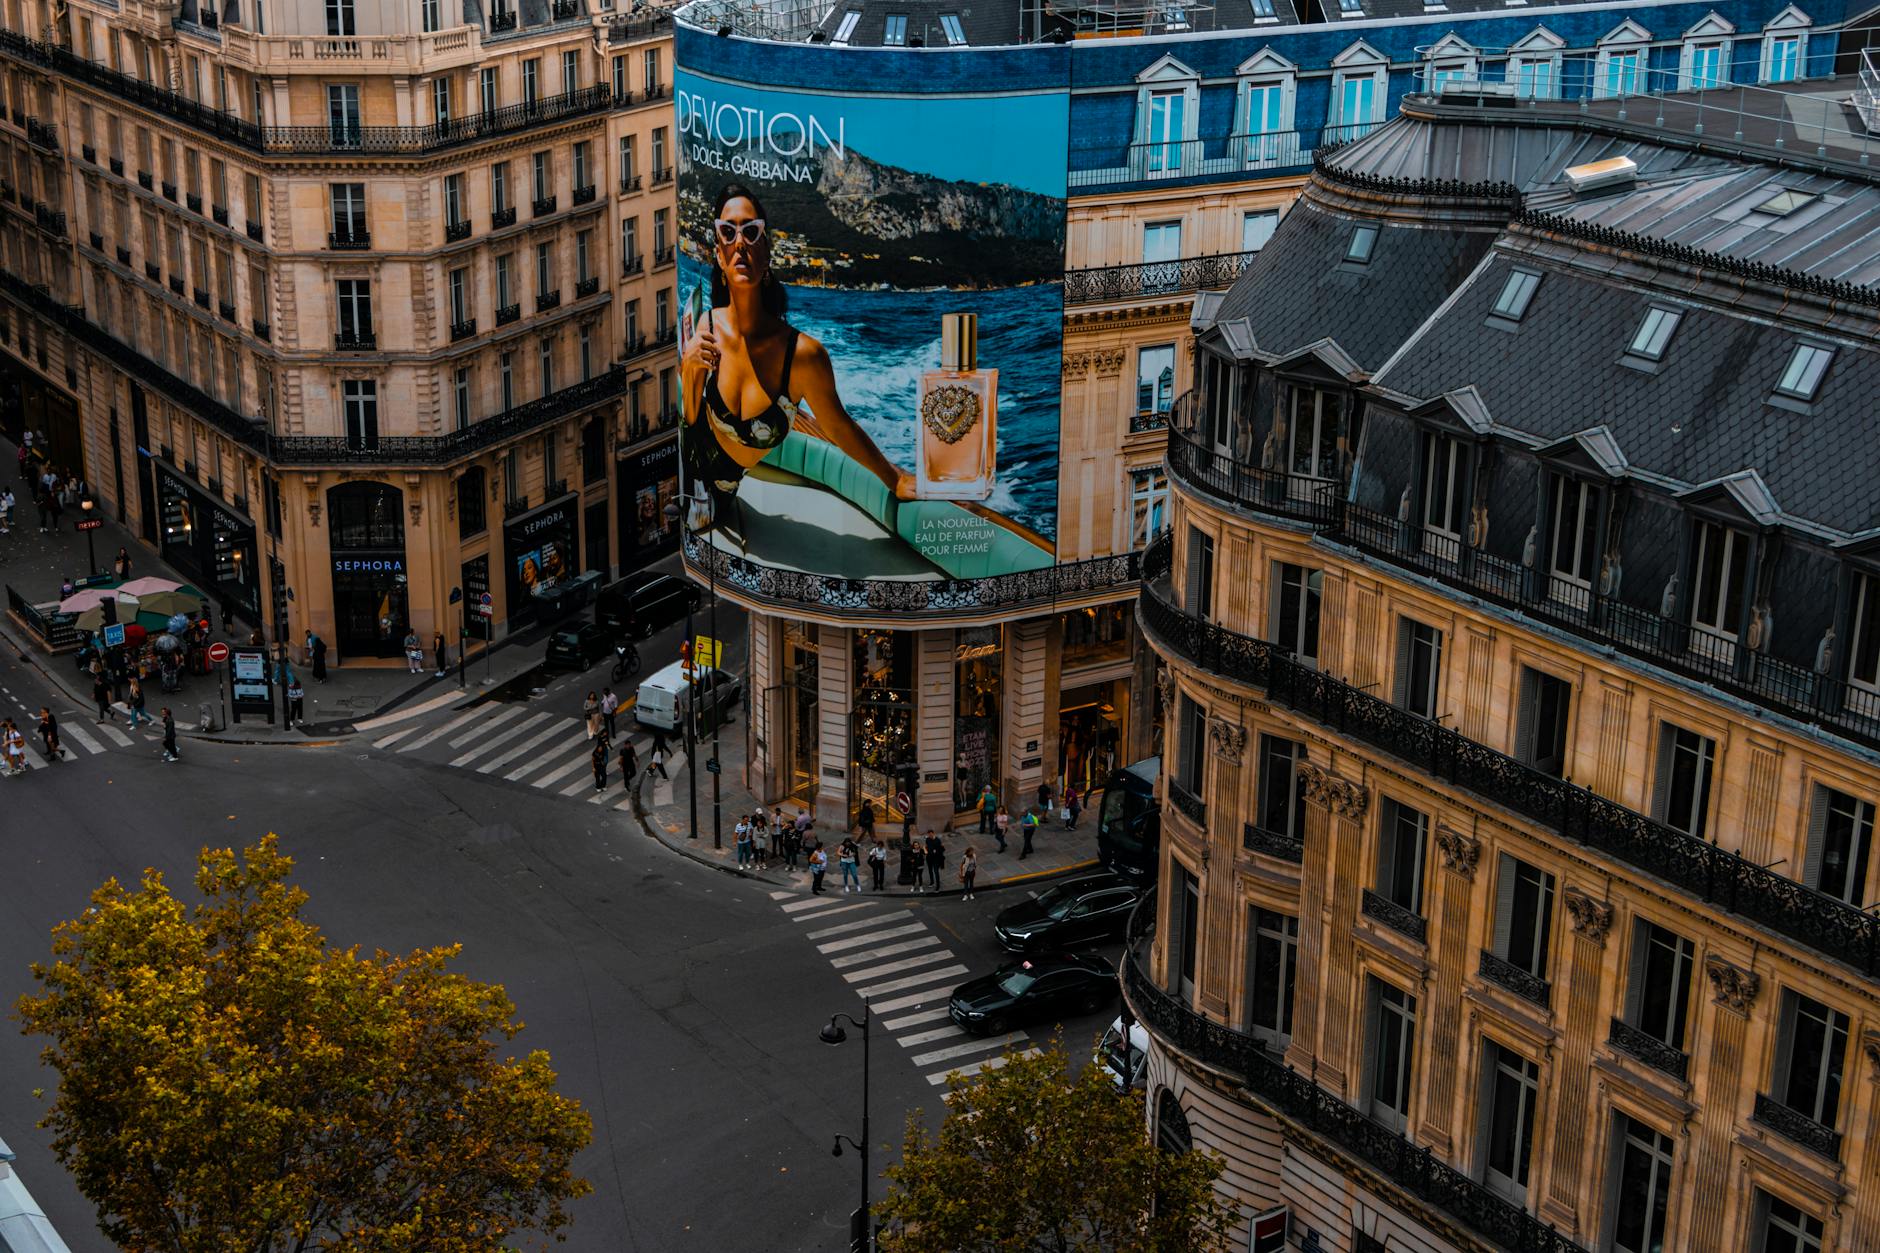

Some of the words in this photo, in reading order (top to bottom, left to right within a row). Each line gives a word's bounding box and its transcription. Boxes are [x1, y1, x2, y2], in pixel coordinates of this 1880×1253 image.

[678, 90, 844, 161] DEVOTION
[692, 144, 724, 171] DOLCE
[724, 162, 731, 172] &
[731, 155, 814, 184] GABBANA
[641, 443, 677, 467] SEPHORA
[164, 474, 189, 498] SEPHORA
[213, 509, 240, 532] SEPHORA
[524, 510, 565, 536] SEPHORA
[922, 520, 934, 530] LA
[937, 516, 989, 529] NOUVELLE
[915, 533, 936, 543] EAU
[939, 531, 953, 542] DE
[956, 529, 996, 540] PARFUM
[921, 545, 950, 556] POUR
[953, 542, 989, 553] FEMME
[335, 560, 403, 571] SEPHORA
[962, 730, 987, 742] ETAM
